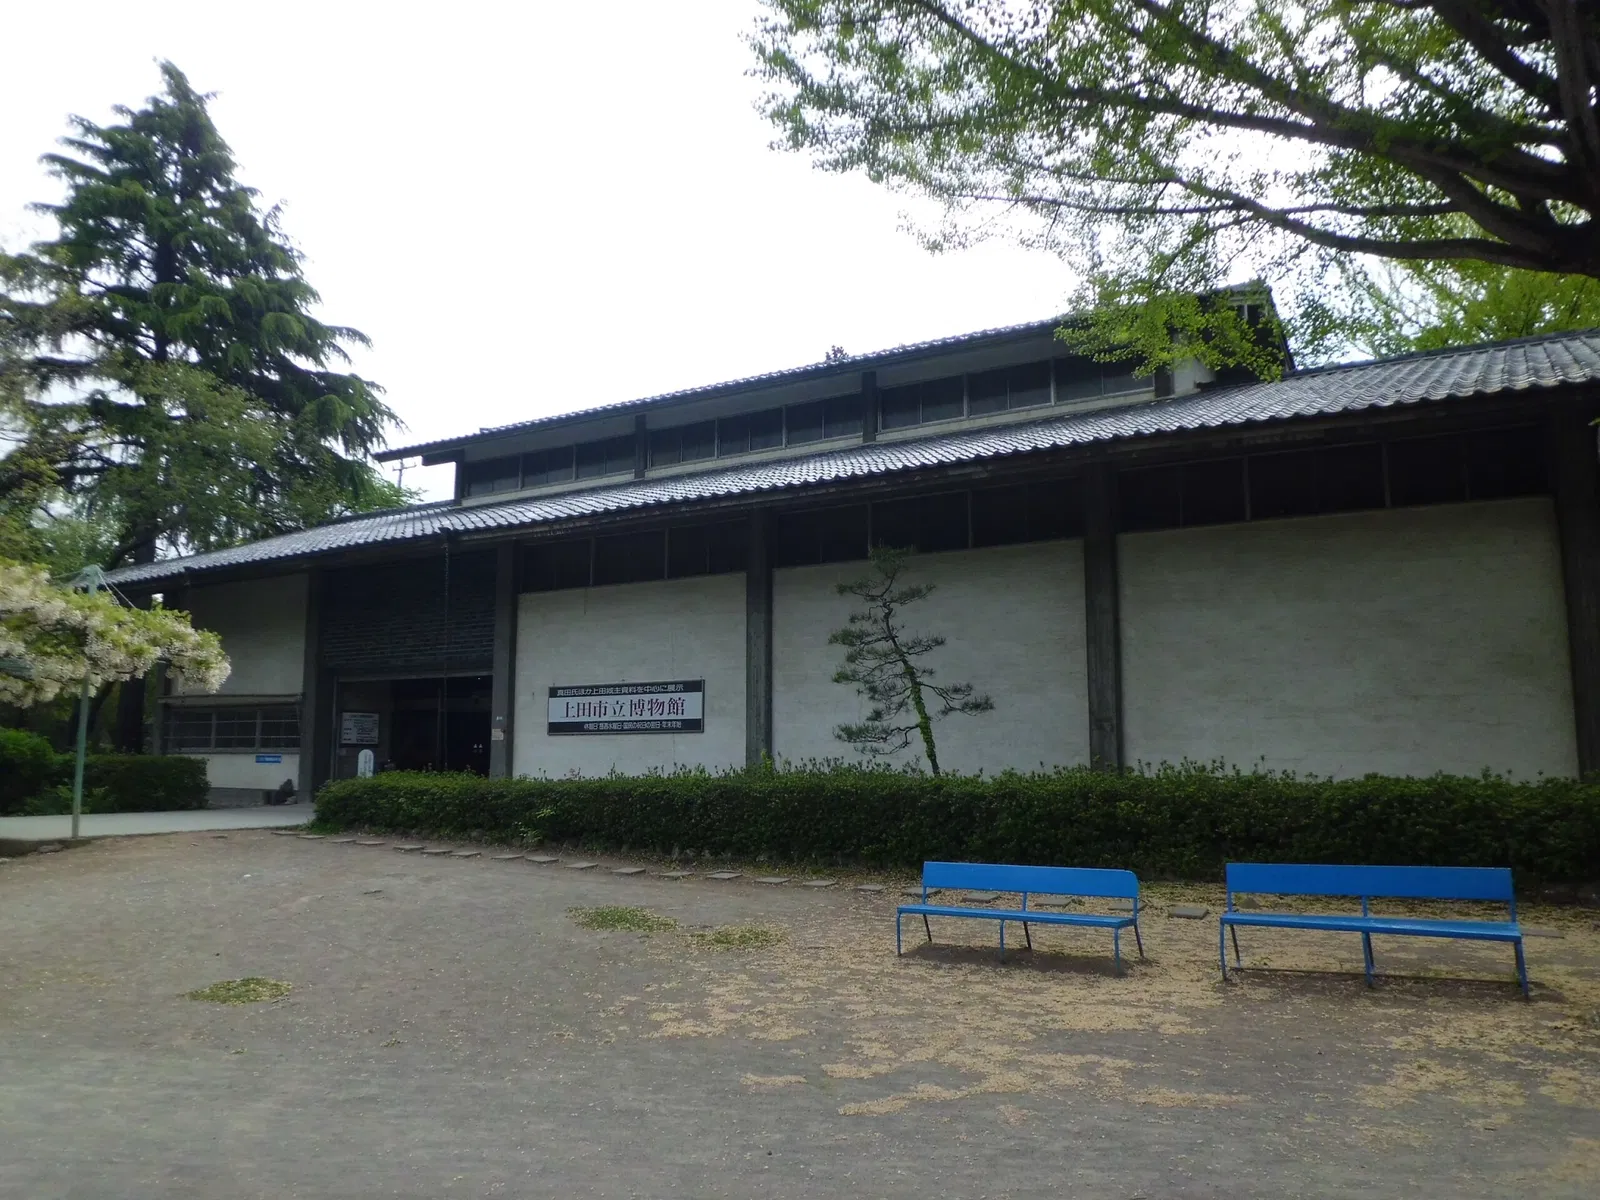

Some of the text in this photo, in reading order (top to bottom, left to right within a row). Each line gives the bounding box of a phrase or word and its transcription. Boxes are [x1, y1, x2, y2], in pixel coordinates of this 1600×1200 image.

[560, 697, 686, 718] 上田市立博物館
